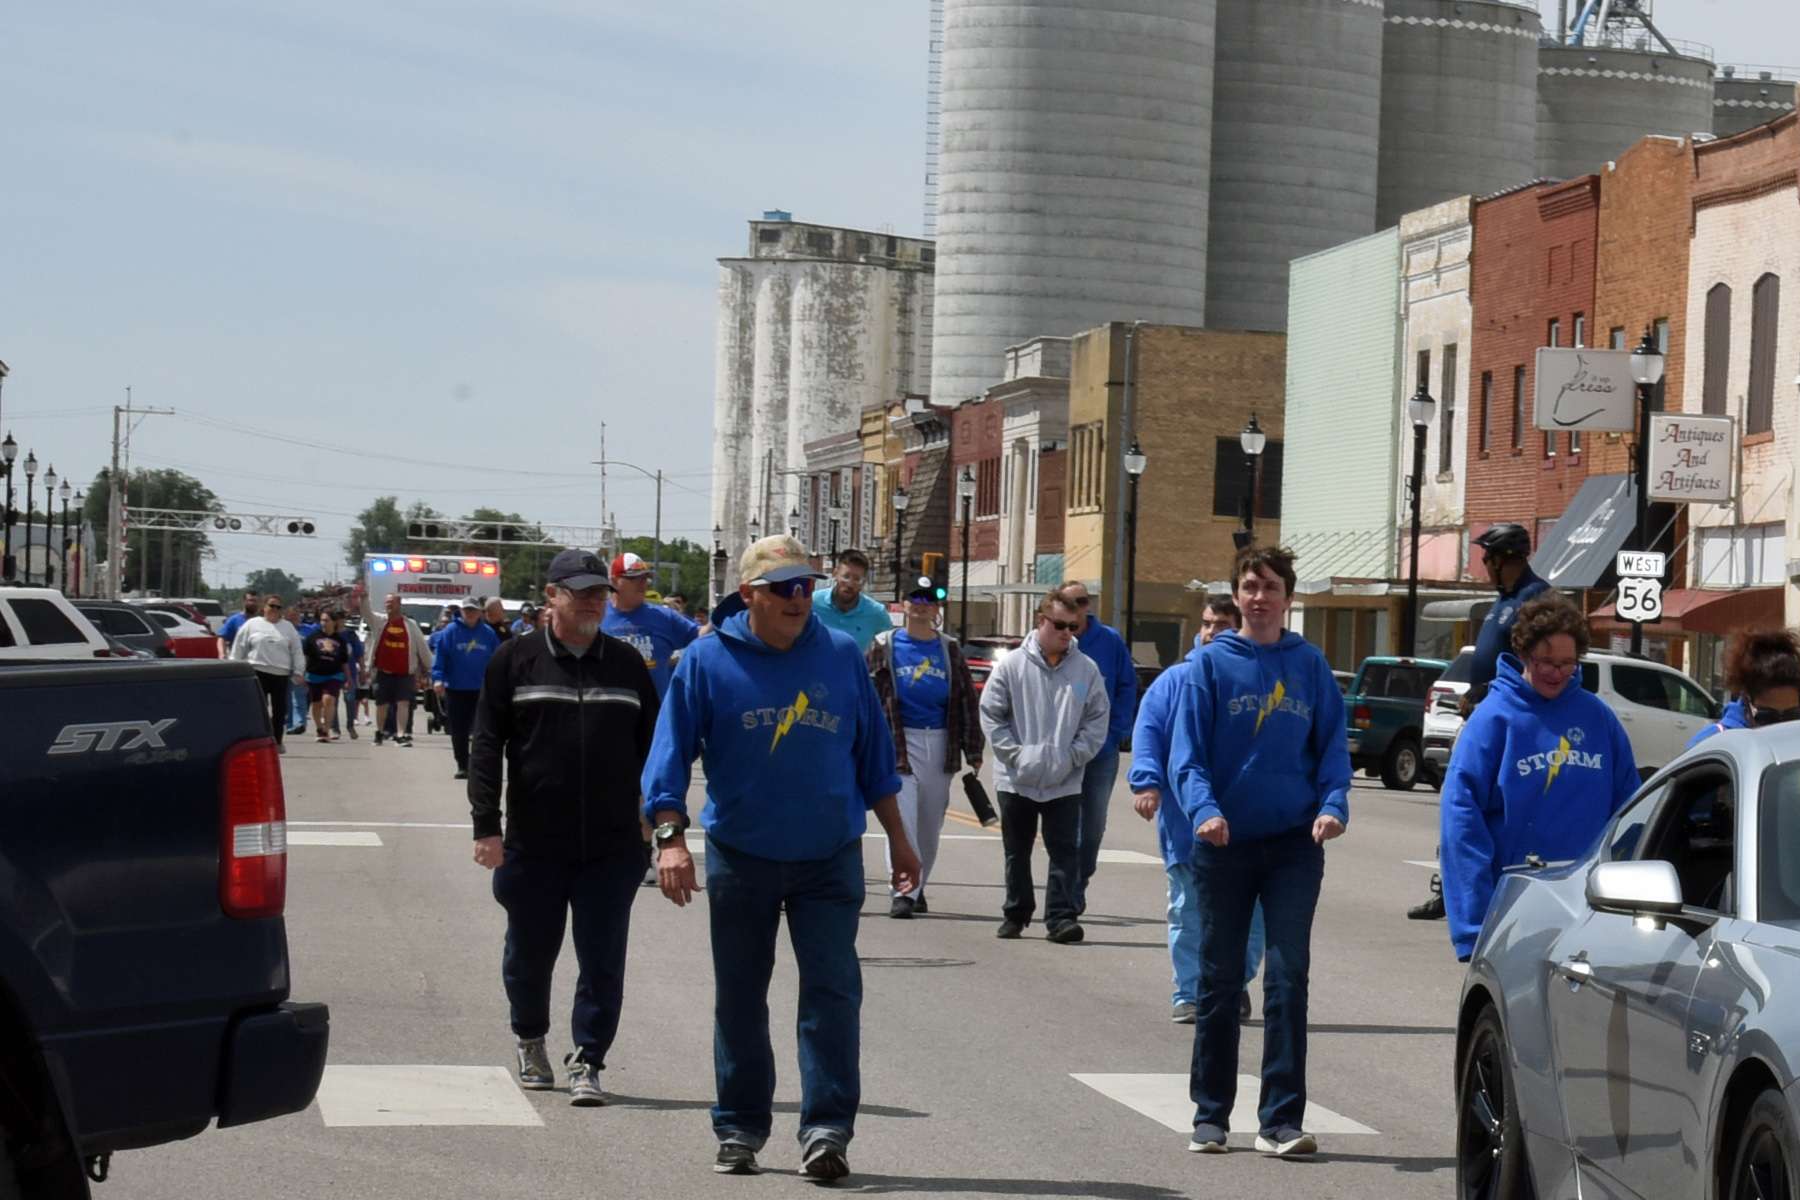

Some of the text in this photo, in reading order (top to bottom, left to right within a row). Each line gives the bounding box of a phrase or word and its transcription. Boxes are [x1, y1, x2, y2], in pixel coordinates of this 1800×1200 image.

[1660, 423, 1725, 446] Antiques
[1673, 448, 1708, 468] And
[1655, 471, 1721, 491] Artifacts
[1623, 556, 1660, 573] WEST
[436, 584, 472, 594] COUNTY
[1622, 586, 1657, 611] 56
[741, 705, 840, 734] STORM
[1228, 695, 1310, 720] STORM
[46, 718, 178, 754] STX
[1517, 749, 1602, 776] STORM
